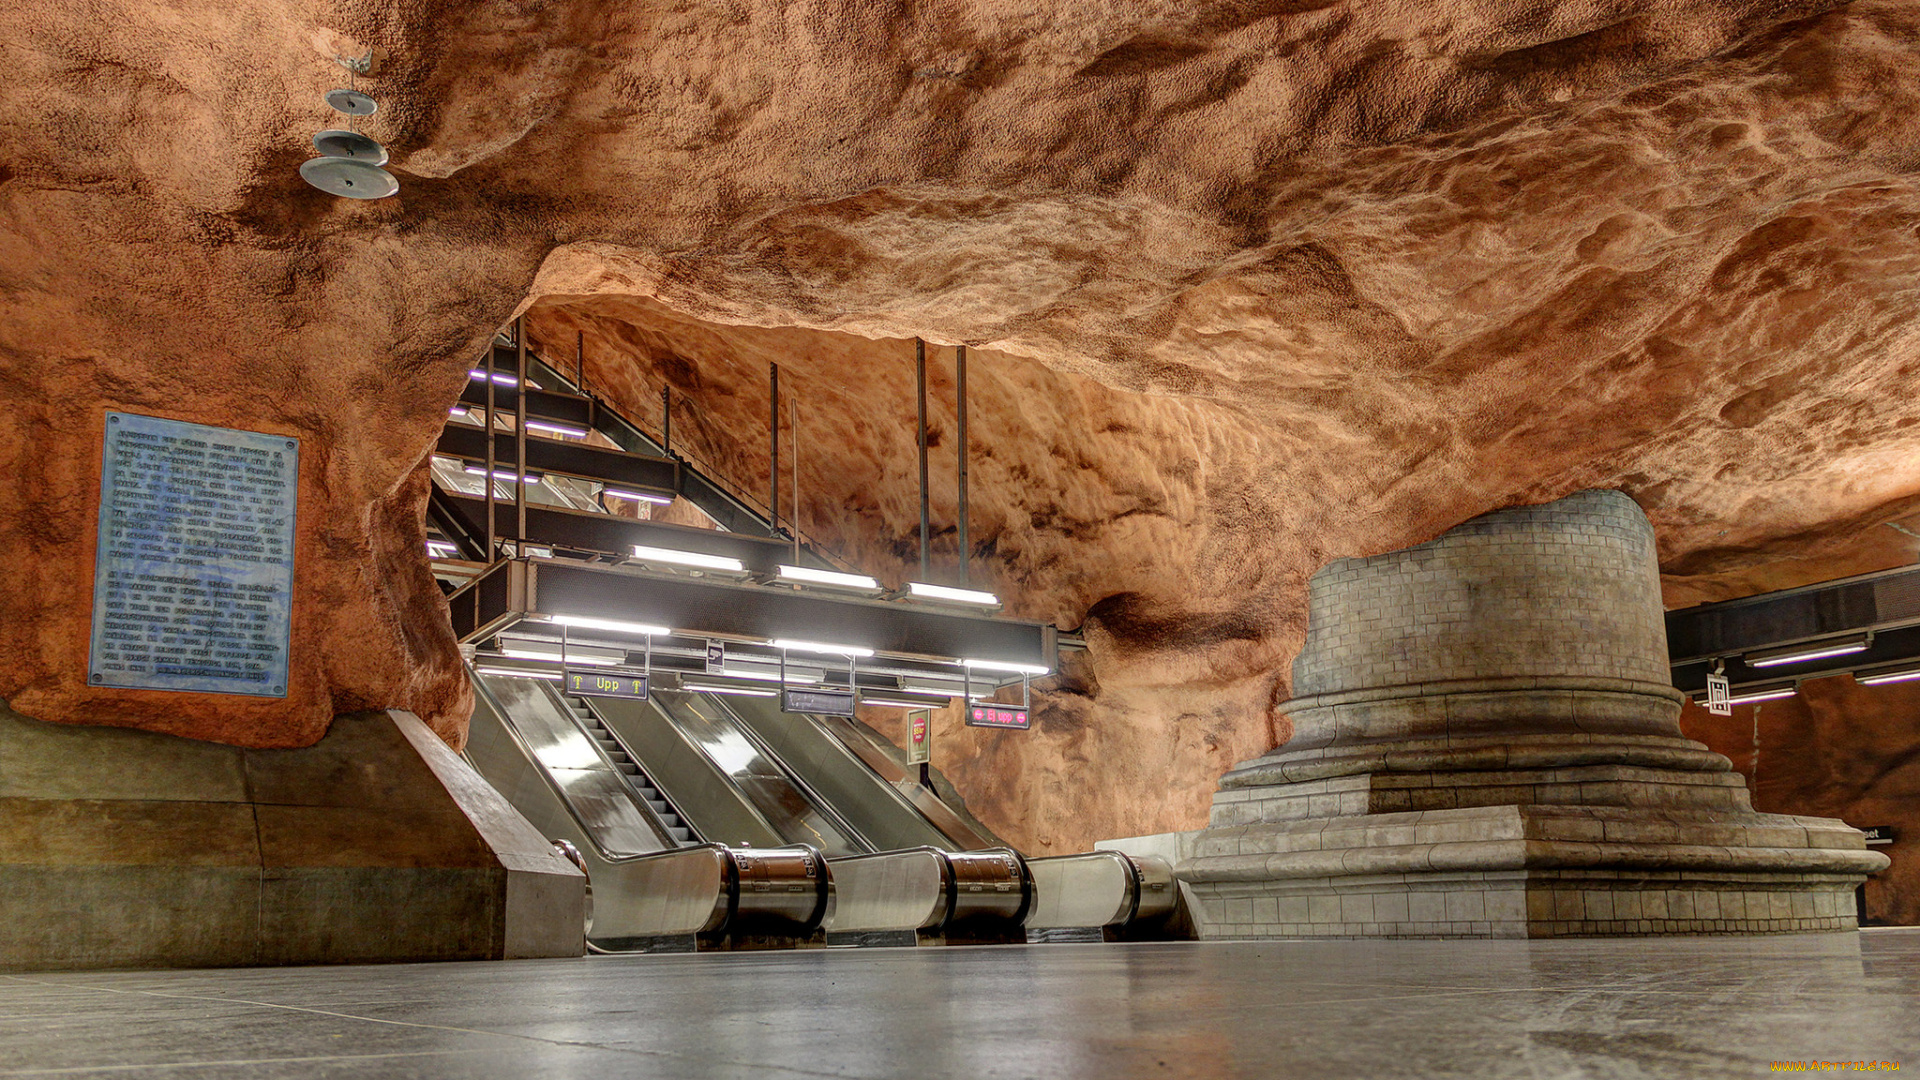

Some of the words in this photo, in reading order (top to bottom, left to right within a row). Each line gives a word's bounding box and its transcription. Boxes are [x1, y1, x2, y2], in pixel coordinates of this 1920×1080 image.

[597, 677, 619, 692] Upp
[987, 709, 997, 723] Ej
[998, 712, 1014, 724] upp
